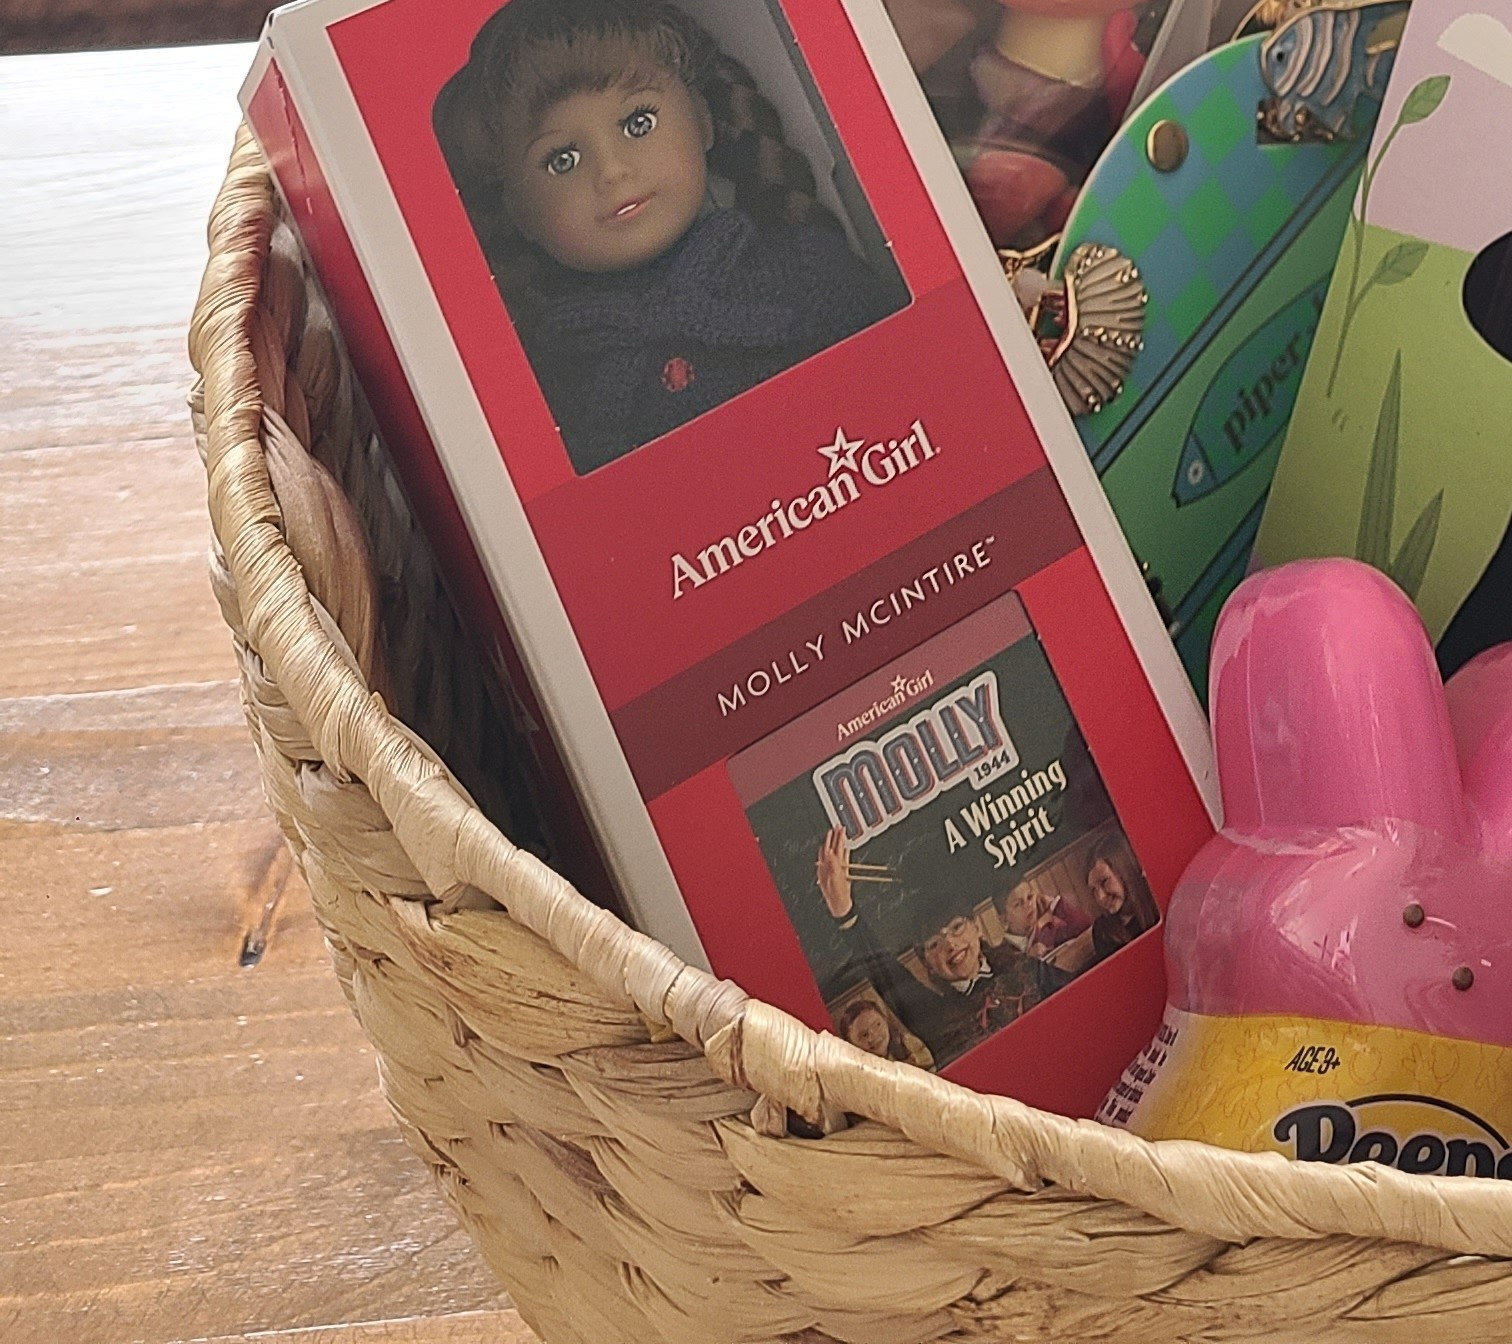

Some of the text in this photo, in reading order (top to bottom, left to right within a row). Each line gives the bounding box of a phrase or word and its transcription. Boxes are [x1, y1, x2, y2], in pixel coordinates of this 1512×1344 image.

[670, 418, 942, 600] American Girl
[716, 633, 825, 718] MOLLY
[836, 668, 935, 742] American Girl
[820, 682, 1004, 842] MOLLY
[972, 749, 1012, 783] 1944
[943, 759, 1068, 855] A Winning
[983, 805, 1057, 869] Spirit
[1284, 1045, 1326, 1073] AGE
